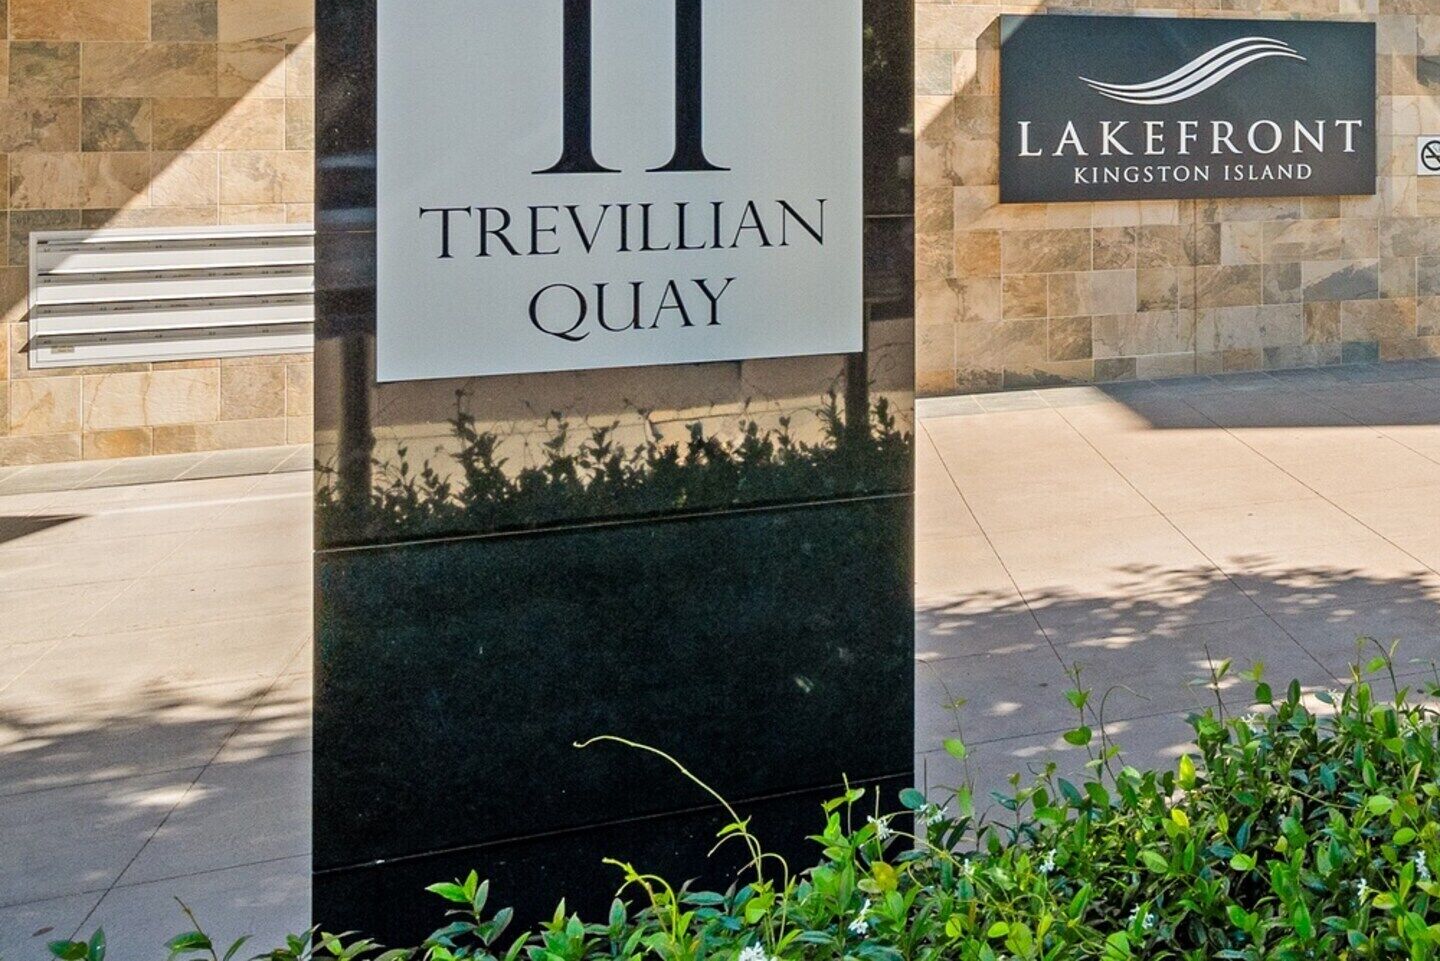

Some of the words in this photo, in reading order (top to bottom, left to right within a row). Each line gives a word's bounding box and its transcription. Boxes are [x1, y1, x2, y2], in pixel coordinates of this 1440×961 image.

[1017, 119, 1363, 158] LAKEFRONT
[1073, 165, 1211, 185] KINGSTON
[1224, 163, 1313, 182] ISLAND
[418, 198, 828, 259] TREVILLIAN
[527, 276, 738, 342] QUAY
